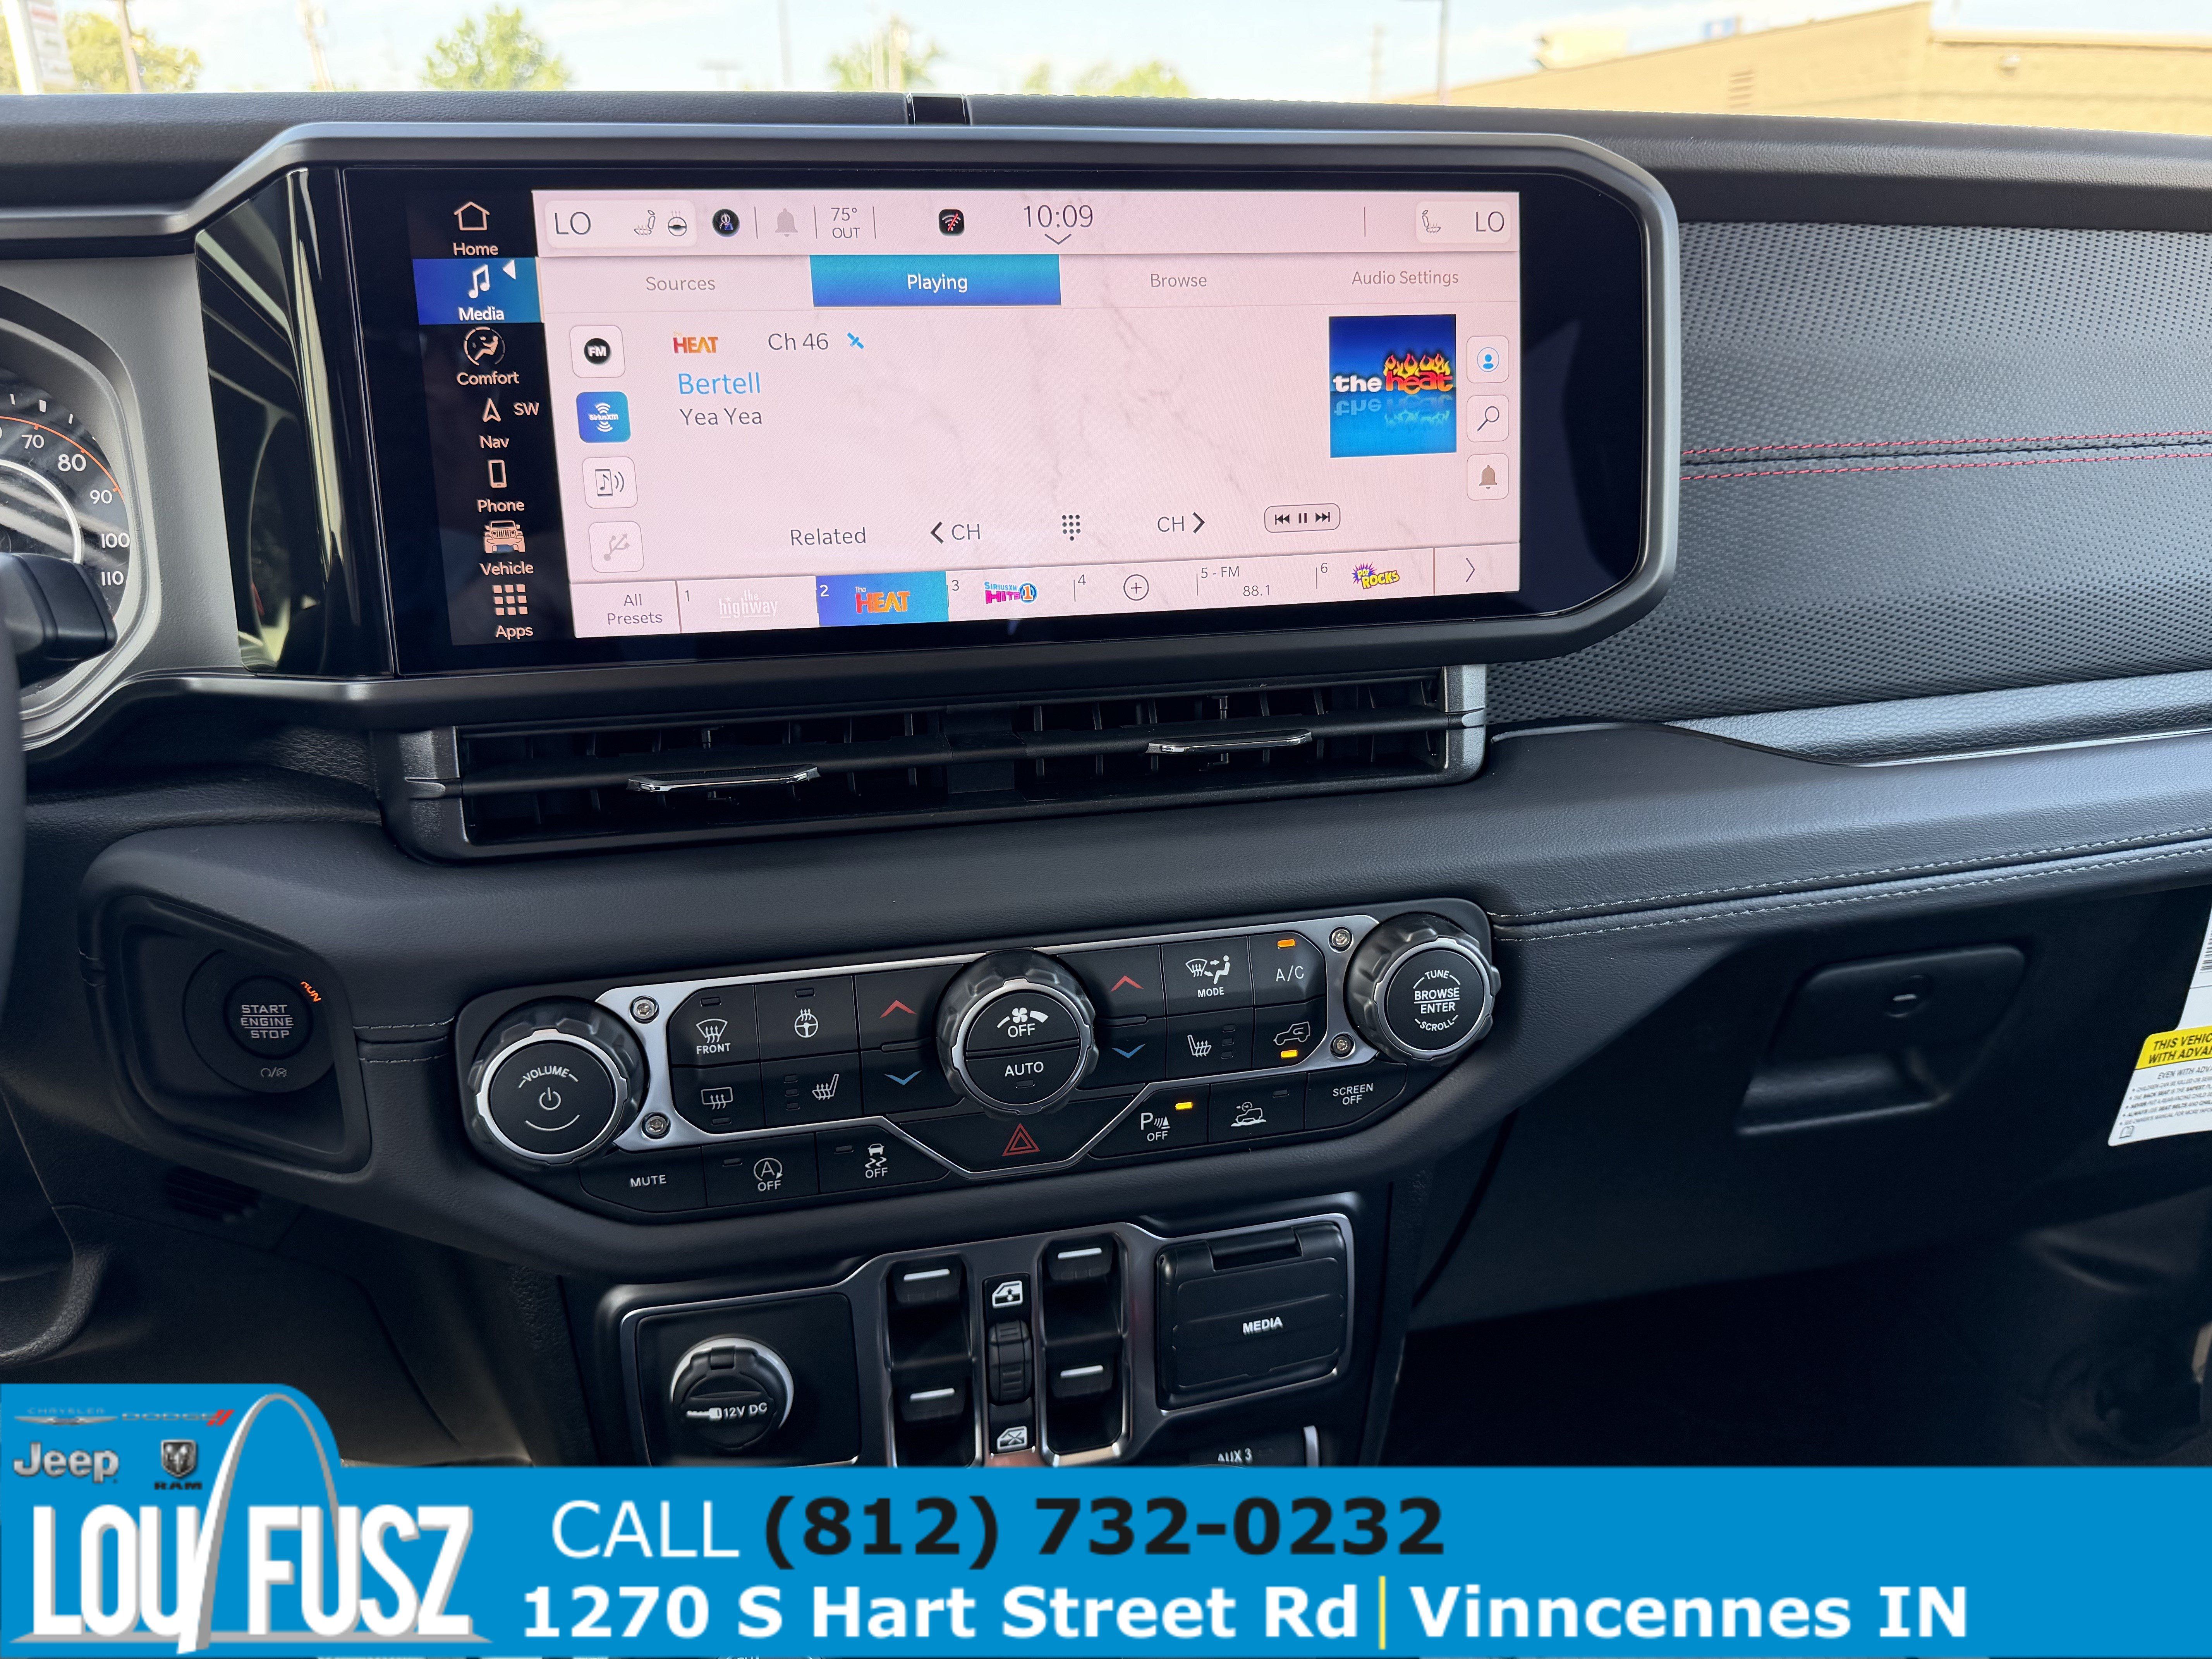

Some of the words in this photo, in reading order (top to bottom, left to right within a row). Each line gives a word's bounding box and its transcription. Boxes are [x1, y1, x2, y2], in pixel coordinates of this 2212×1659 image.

[555, 211, 591, 235] LO
[1024, 204, 1093, 228] 10:09
[1475, 211, 1504, 232] LO
[832, 227, 860, 239] OUT
[453, 242, 498, 256] Home
[646, 276, 716, 290] Sources
[907, 273, 968, 293] Playing
[1150, 273, 1207, 288] Browse
[1352, 270, 1395, 285] Audio
[1400, 270, 1459, 287] Settings
[458, 306, 505, 321] Media
[673, 336, 719, 354] HEAT
[768, 333, 795, 350] Ch
[802, 333, 829, 350] 46
[588, 346, 607, 357] FM
[457, 371, 520, 385] Comfort
[678, 372, 761, 395] Bertell
[1333, 375, 1382, 392] the
[1385, 370, 1453, 394] heat
[514, 402, 539, 416] SW
[679, 408, 719, 426] Yea
[724, 407, 763, 425] Yea
[21, 434, 45, 449] 70
[479, 435, 509, 449] Nav
[58, 453, 86, 472] 80
[90, 489, 112, 504] 90
[477, 499, 525, 512] Phone
[1157, 516, 1184, 533] CH
[790, 527, 866, 546] Related
[951, 524, 981, 541] CH
[101, 532, 130, 548] 100
[479, 561, 534, 575] Vehicle
[1201, 567, 1208, 578] 5
[1220, 566, 1240, 578] FM
[1321, 562, 1328, 574] 6
[1357, 568, 1370, 579] POP
[101, 571, 124, 586] 110
[951, 580, 960, 591] 3
[1078, 574, 1086, 586] 4
[1361, 570, 1400, 589] ROCKS
[684, 590, 690, 602] 1
[744, 589, 759, 601] the
[819, 584, 829, 597] 2
[985, 590, 1021, 604] HITS
[1243, 585, 1271, 597] 88.1
[623, 593, 642, 607] All
[855, 591, 910, 614] HEAT
[718, 598, 778, 618] highway
[607, 612, 663, 625] Presets
[495, 625, 533, 640] Apps
[1276, 965, 1304, 982] A/C
[1424, 970, 1449, 980] TUNE
[1197, 987, 1224, 998] MODE
[1414, 988, 1460, 1001] BROWSE
[242, 1004, 288, 1013] START
[1420, 1002, 1455, 1015] ENTER
[240, 1017, 294, 1026] ENGINE
[1419, 1018, 1454, 1031] SCROLL
[251, 1030, 290, 1039] STOP
[1008, 1023, 1036, 1038] OFF
[696, 1042, 731, 1054] FRONT
[2153, 1037, 2179, 1051] THIS
[2148, 1050, 2177, 1064] WITH
[523, 1065, 570, 1084] VOLUME
[1005, 1061, 1044, 1077] AUTO
[1333, 1083, 1374, 1097] SCREEN
[1342, 1094, 1363, 1106] OFF
[1147, 1130, 1168, 1142] OFF
[865, 1167, 888, 1179] OFF
[630, 1175, 667, 1188] MUTE
[757, 1180, 781, 1192] OFF
[1242, 1316, 1283, 1336] MEDIA
[723, 1406, 745, 1419] 12V
[749, 1401, 768, 1417] DC
[1244, 1448, 1253, 1463] 3
